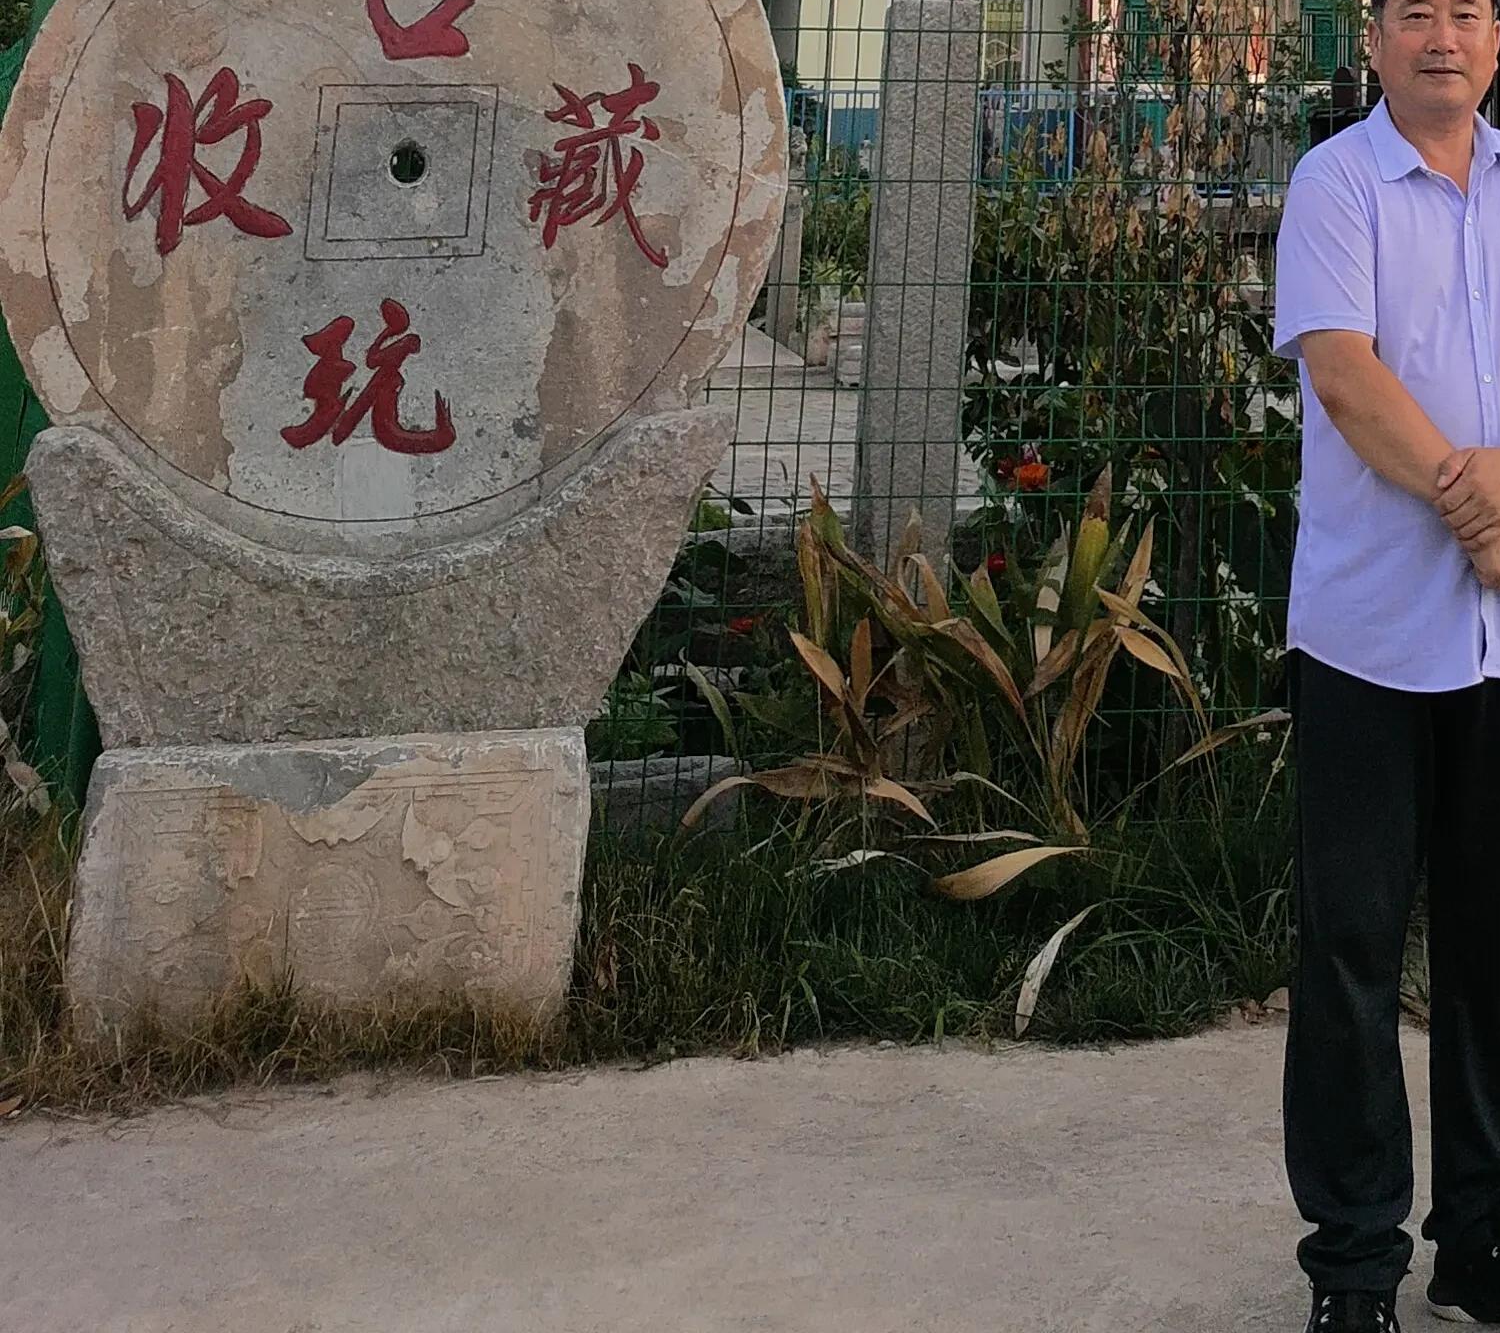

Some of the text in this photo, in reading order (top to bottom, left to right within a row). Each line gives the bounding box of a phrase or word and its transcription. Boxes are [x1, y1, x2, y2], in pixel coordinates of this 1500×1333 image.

[123, 63, 670, 268] 收 藏
[280, 299, 457, 455] 玩
